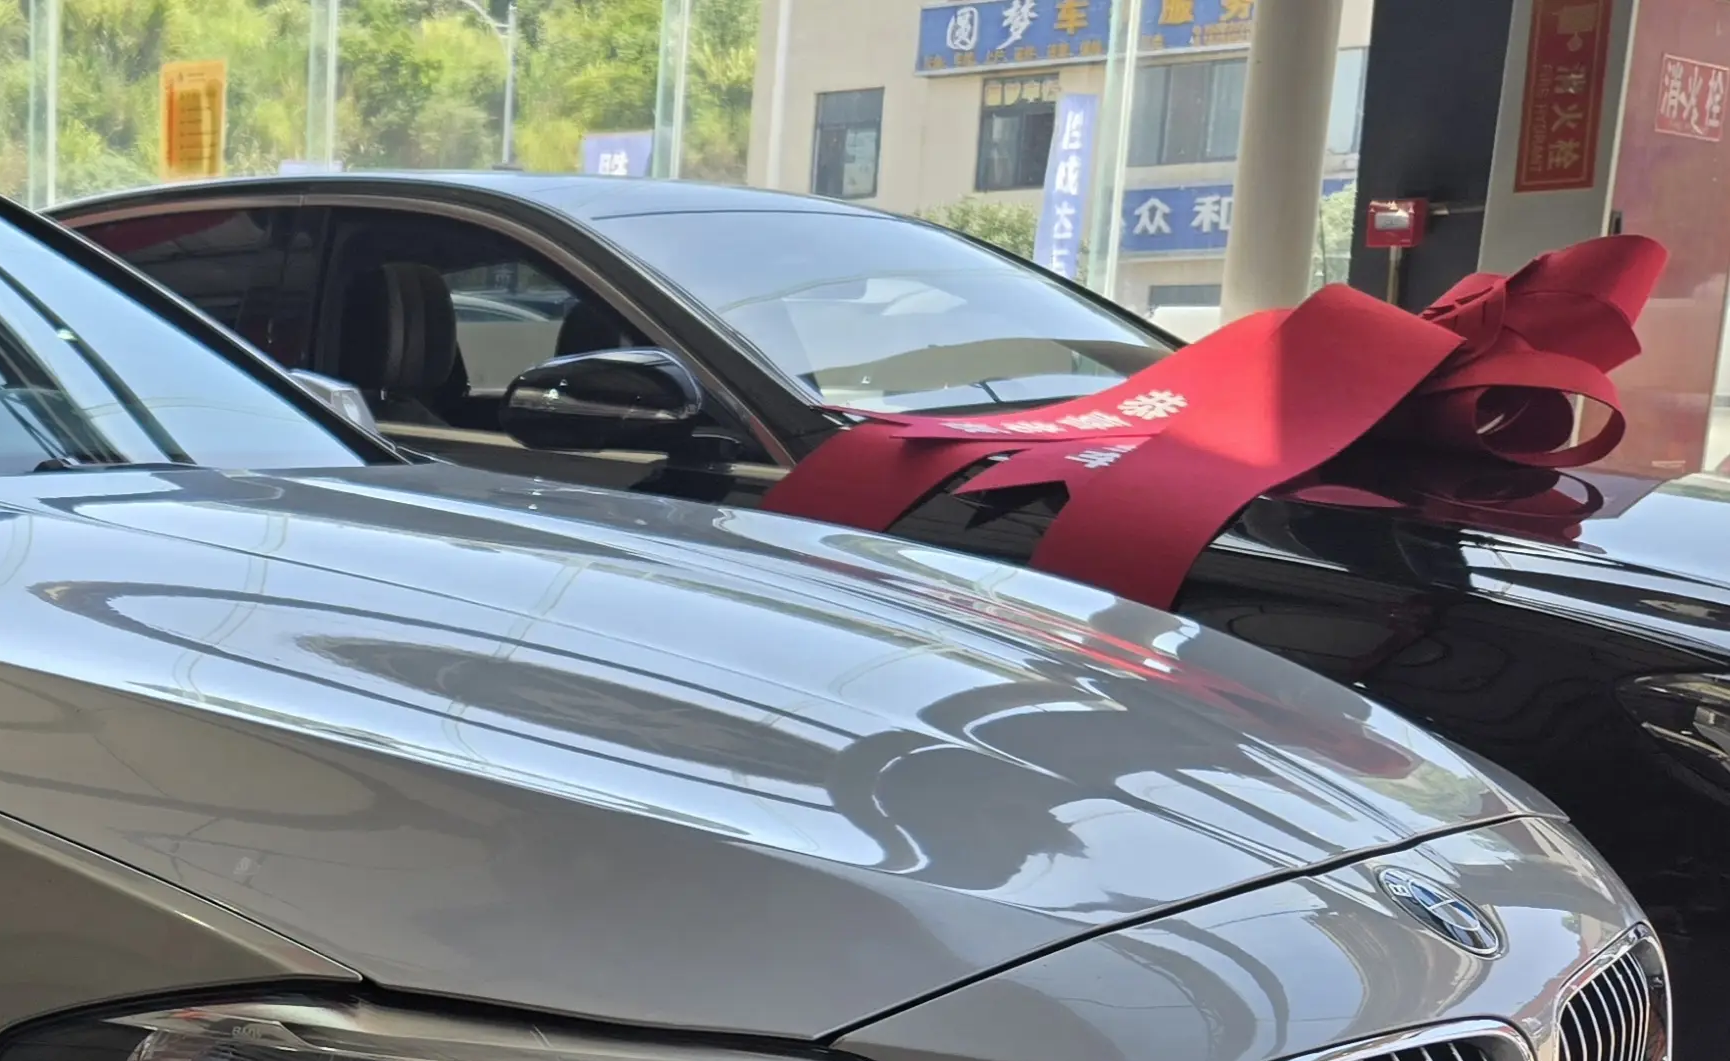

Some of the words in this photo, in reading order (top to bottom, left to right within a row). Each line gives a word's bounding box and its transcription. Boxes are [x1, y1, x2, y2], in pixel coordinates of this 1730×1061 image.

[1660, 61, 1724, 134] 消火栓
[1121, 196, 1233, 236] 众和
